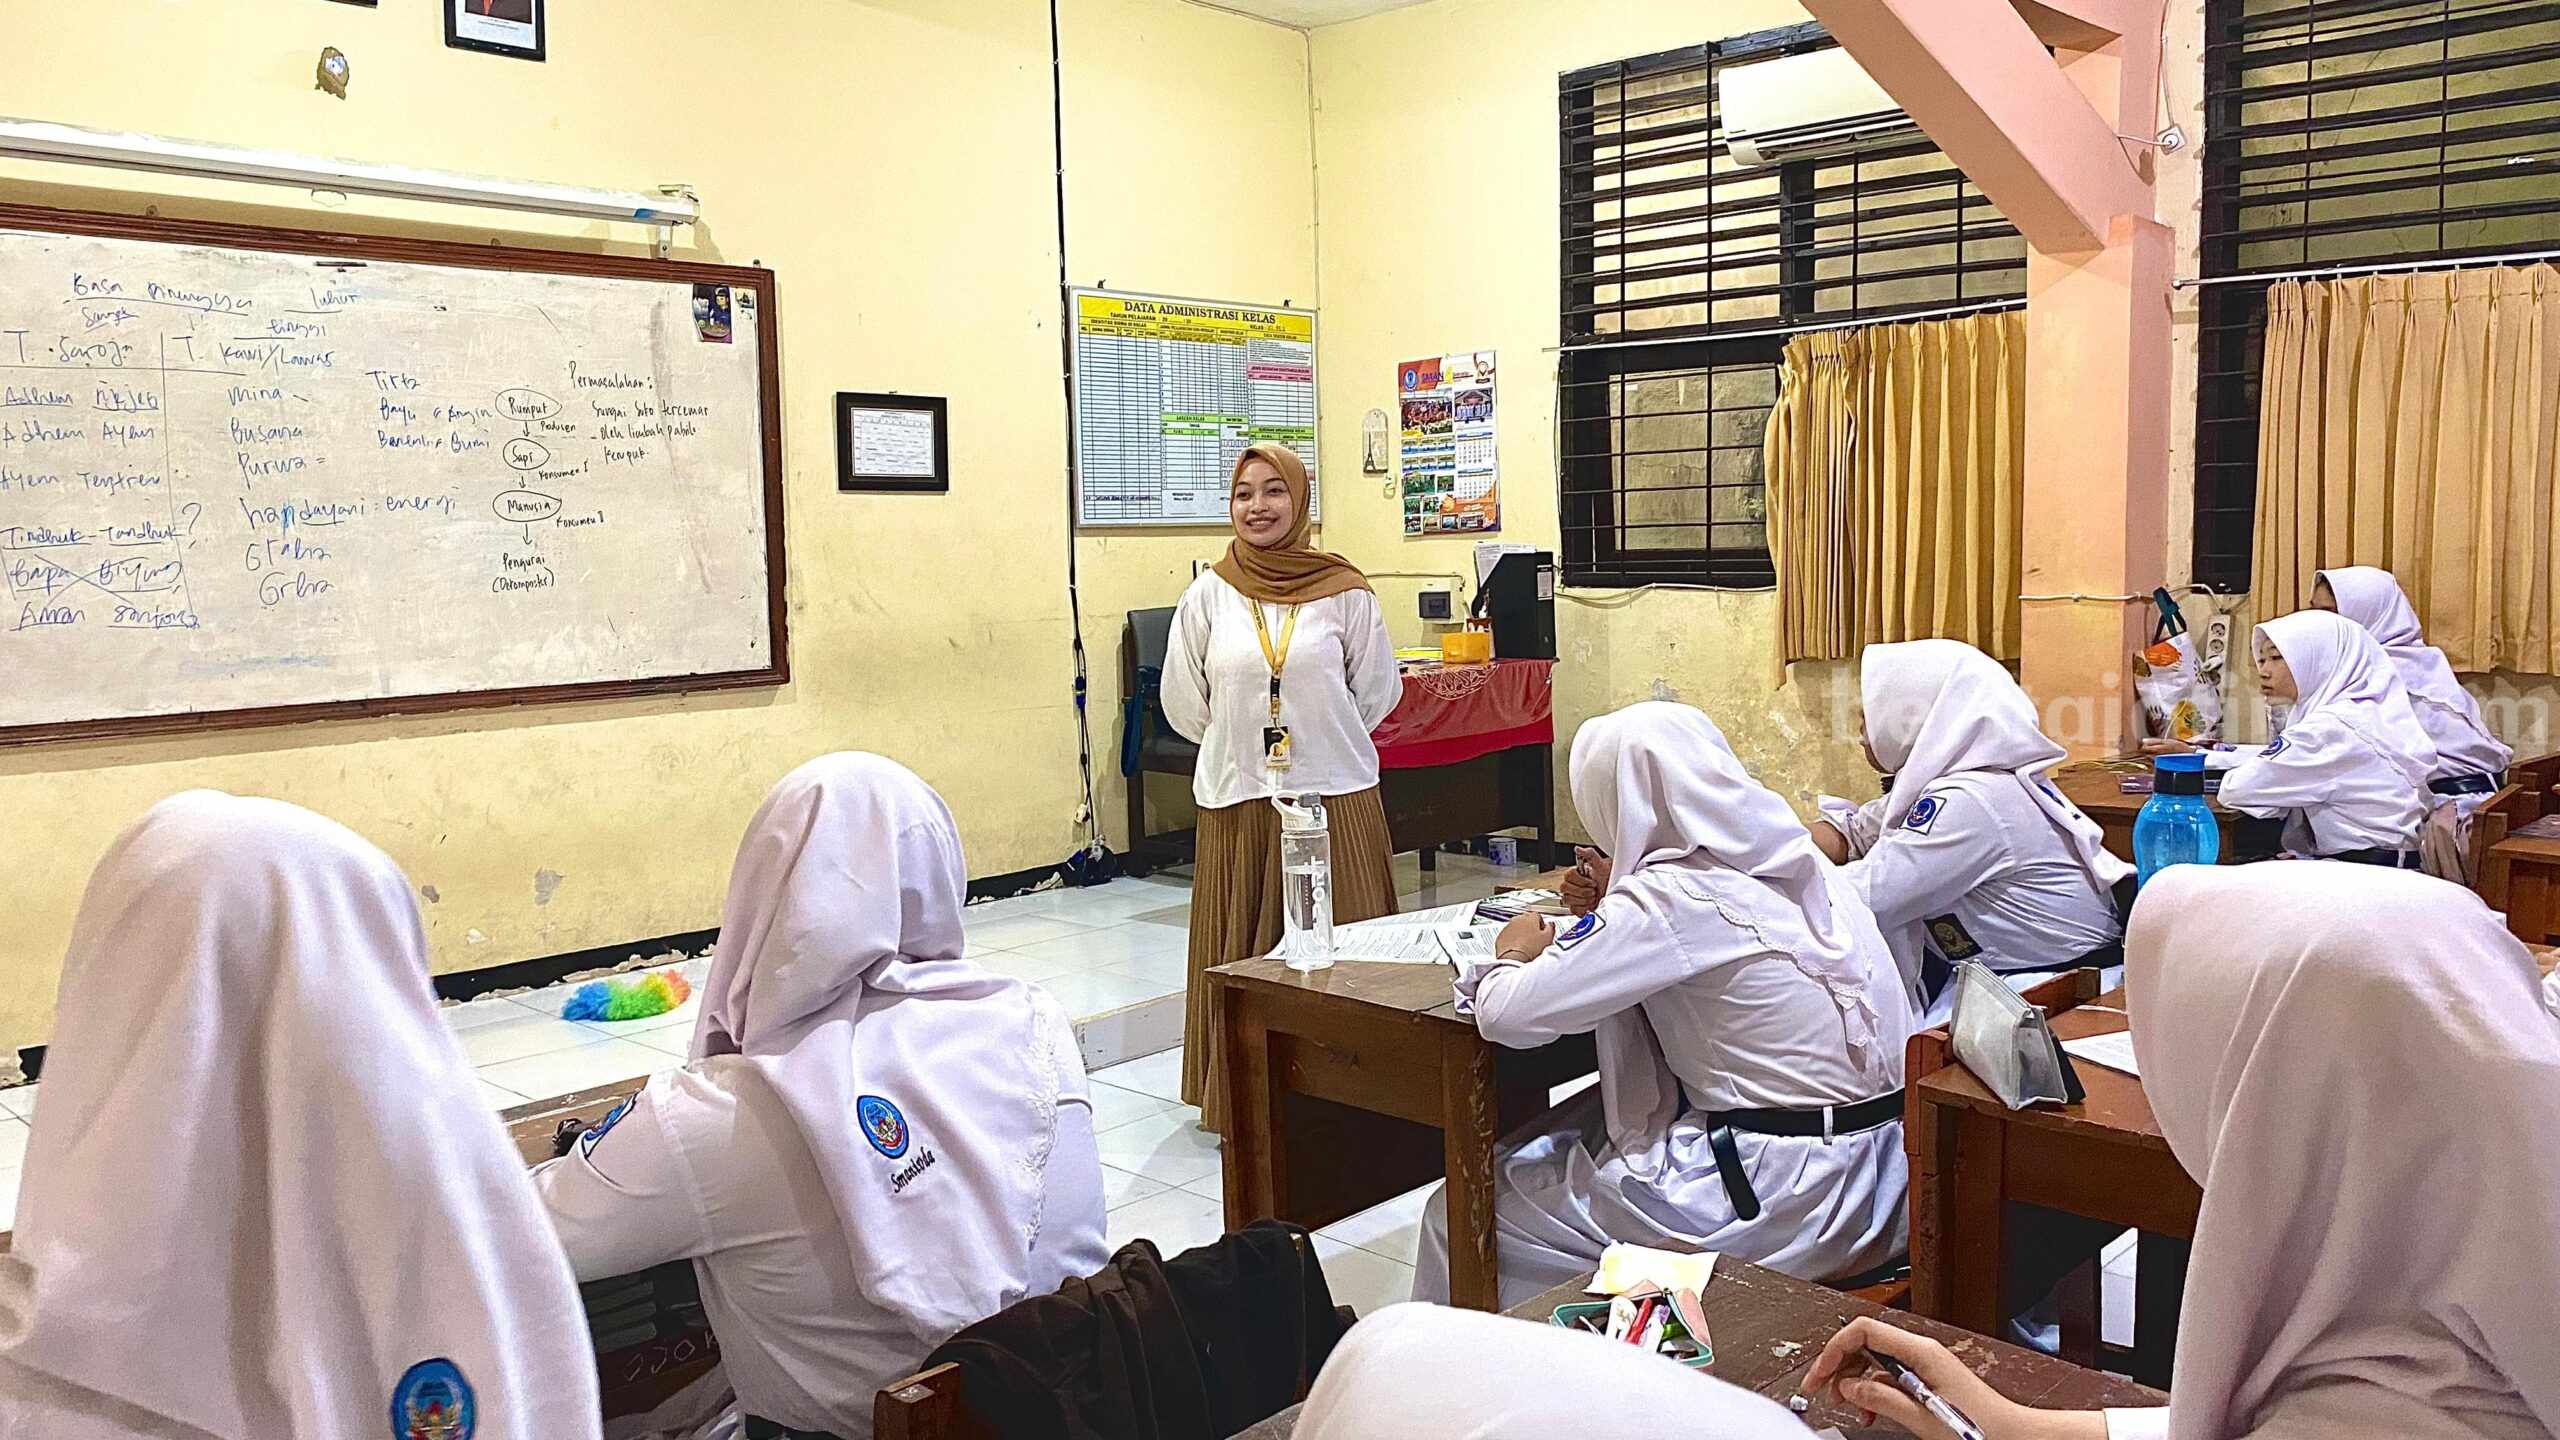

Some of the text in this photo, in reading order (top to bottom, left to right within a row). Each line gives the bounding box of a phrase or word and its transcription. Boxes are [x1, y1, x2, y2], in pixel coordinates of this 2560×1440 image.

[1124, 301, 1276, 325] DATA ADMINISTRASI KELAS
